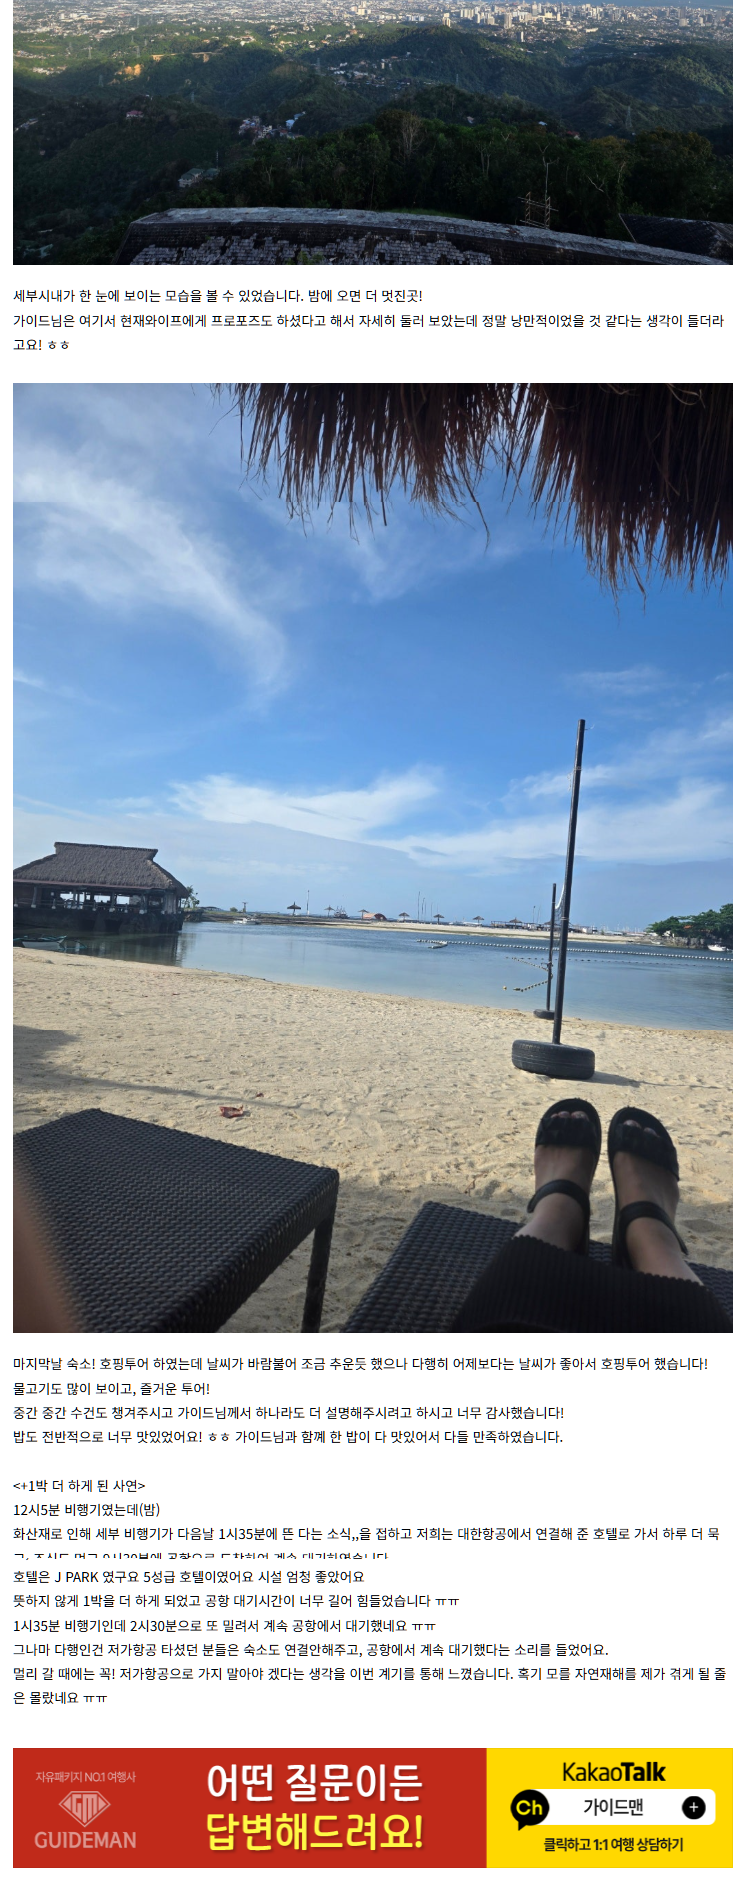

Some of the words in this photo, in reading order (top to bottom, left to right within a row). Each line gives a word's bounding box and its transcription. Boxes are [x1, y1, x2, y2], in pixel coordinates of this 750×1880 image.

[35, 1771, 83, 1783] 자유패키지
[107, 1771, 137, 1783] 여행사
[562, 1761, 667, 1782] KakaoTalk
[207, 1764, 273, 1802] 어떤
[286, 1764, 423, 1802] 질문이든
[516, 1800, 543, 1816] Ch
[584, 1798, 644, 1817] 가이드맨
[34, 1831, 137, 1849] GUIDEMAN
[206, 1812, 423, 1851] 답변해드려요!
[543, 1837, 592, 1852] 클릭하고
[593, 1839, 609, 1851] 1:1
[610, 1837, 635, 1852] 여행
[637, 1837, 684, 1852] 상담하기
